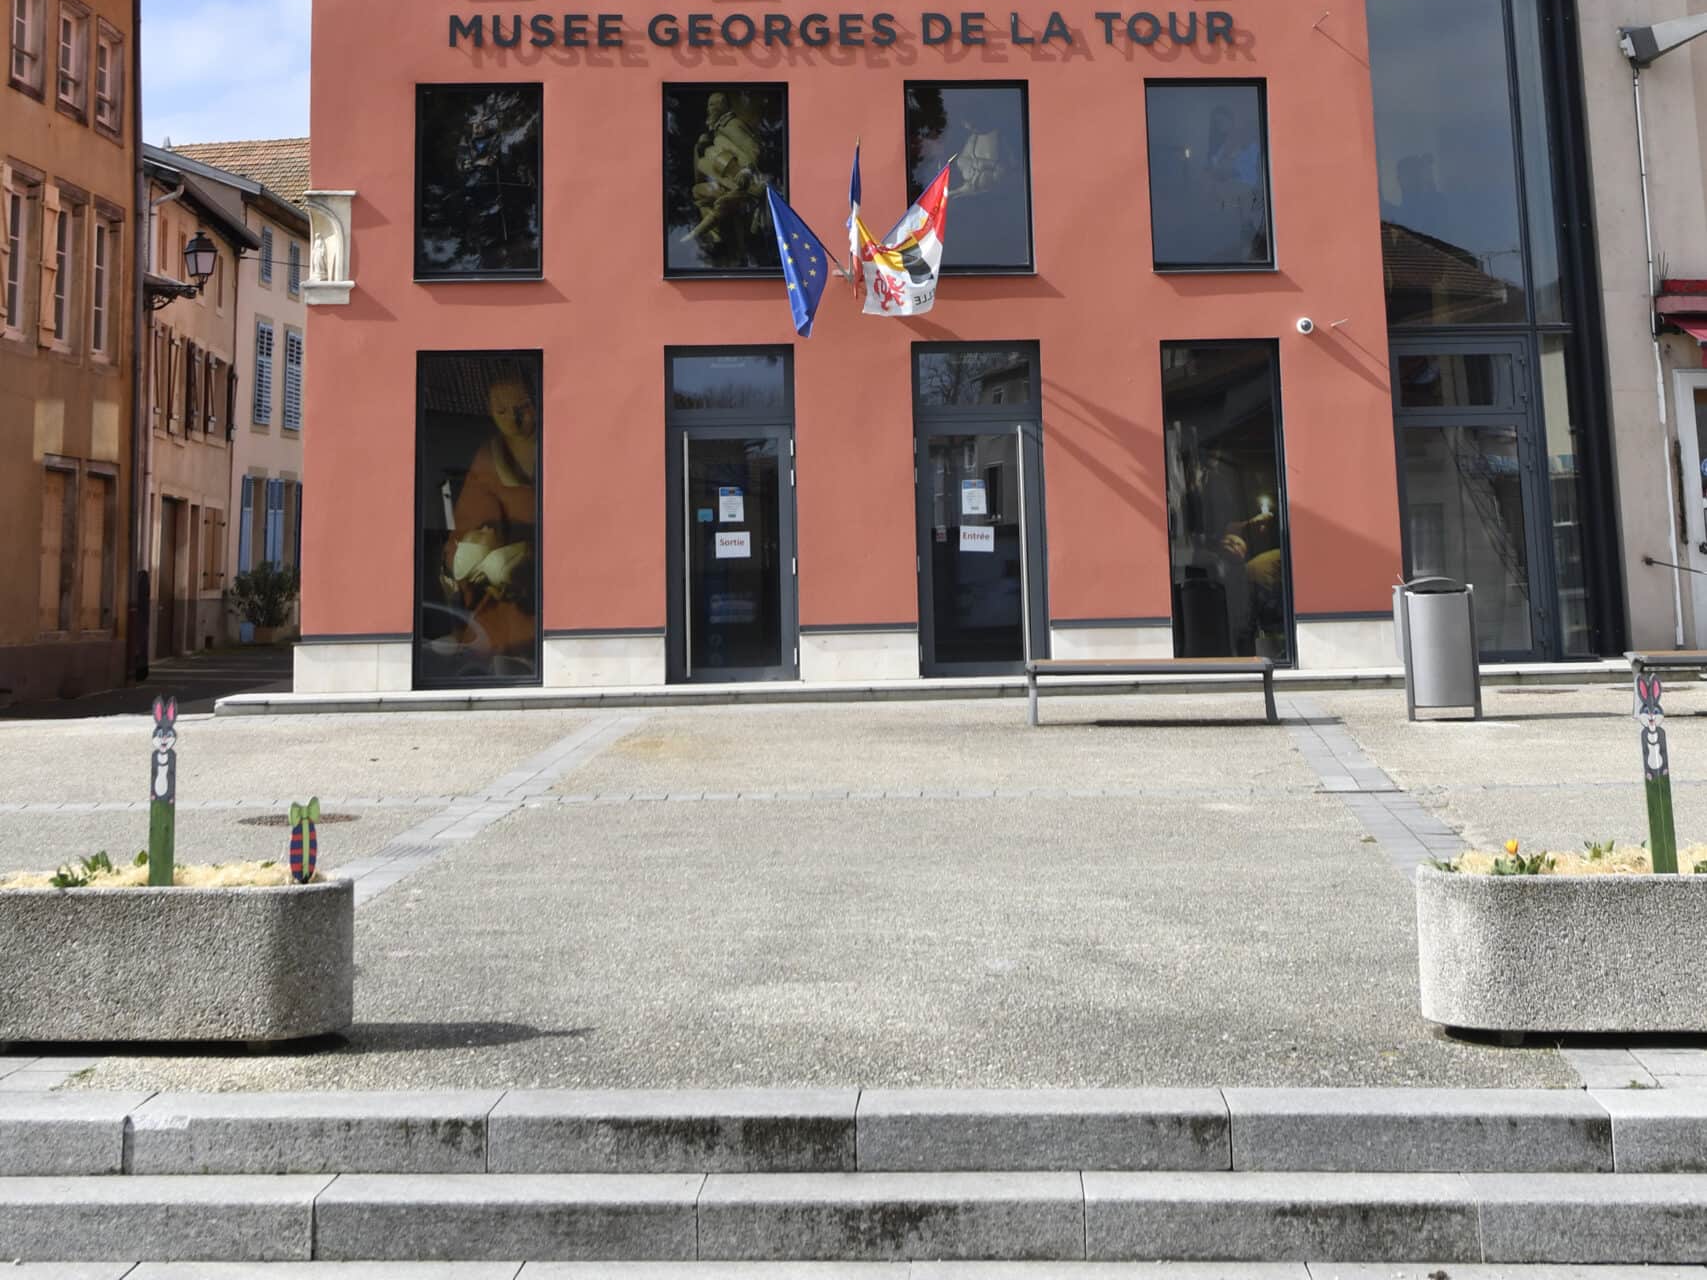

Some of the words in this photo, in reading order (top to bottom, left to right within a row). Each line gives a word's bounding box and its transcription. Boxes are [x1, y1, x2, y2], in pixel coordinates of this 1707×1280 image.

[450, 14, 623, 48] MUSEE
[648, 13, 896, 48] GEORGES
[923, 13, 986, 45] DE
[1011, 12, 1072, 45] LA
[1096, 12, 1232, 46] TOUR
[962, 531, 990, 541] Entrée
[719, 537, 745, 547] Sortie
